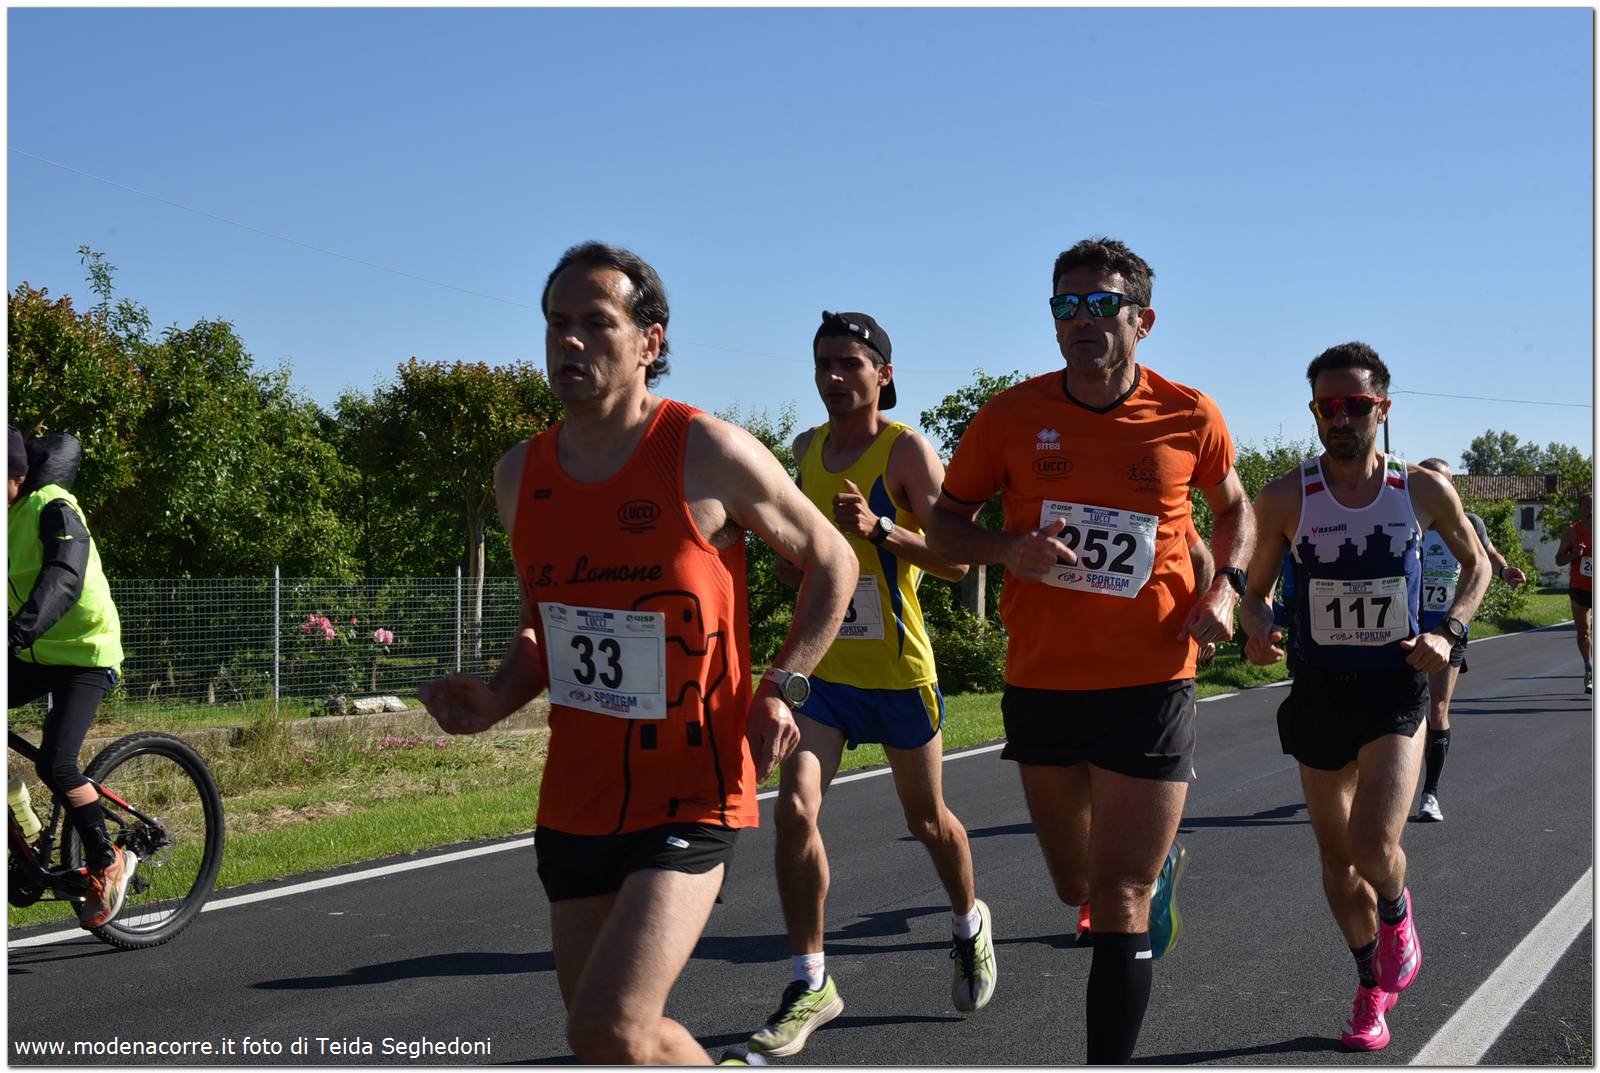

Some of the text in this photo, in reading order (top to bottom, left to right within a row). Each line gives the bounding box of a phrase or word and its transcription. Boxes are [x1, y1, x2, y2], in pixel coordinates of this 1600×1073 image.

[1038, 461, 1067, 472] LUCCI
[623, 506, 654, 520] LUCCI
[1090, 513, 1112, 524] LUCCI
[1312, 523, 1347, 534] Vassalli
[1056, 525, 1138, 575] 252
[565, 555, 663, 584] Lamone
[1584, 561, 1592, 571] 2
[1086, 573, 1130, 588] SPORTGM
[1425, 586, 1447, 603] 73
[1326, 596, 1392, 629] 117
[585, 616, 608, 628] LUCCI
[1355, 631, 1391, 640] SPORTGM
[570, 635, 623, 689] 33
[594, 691, 637, 707] SPORTGM
